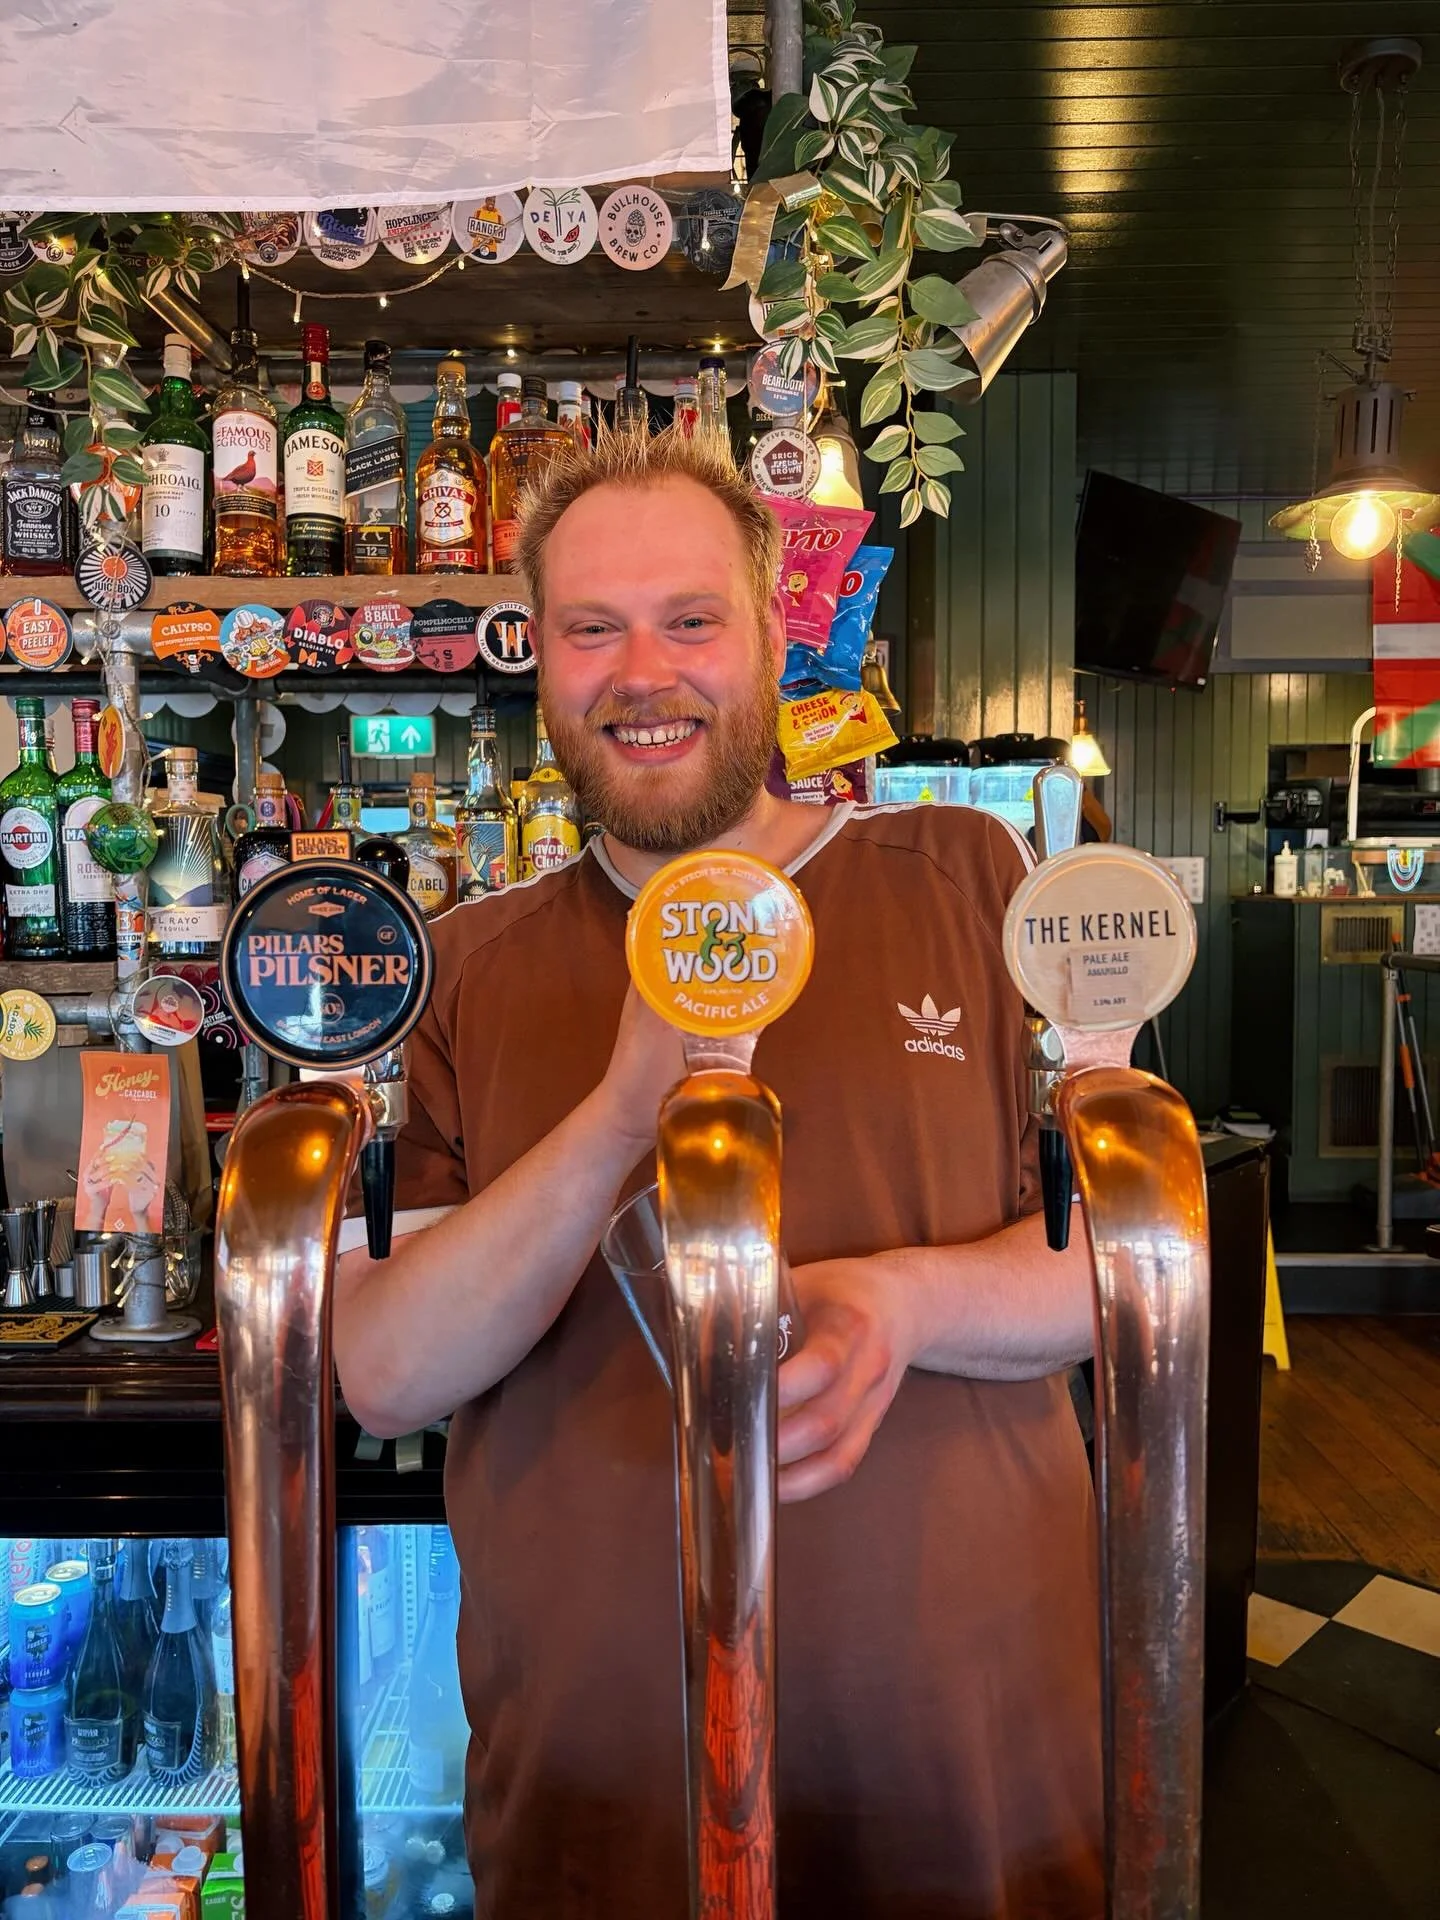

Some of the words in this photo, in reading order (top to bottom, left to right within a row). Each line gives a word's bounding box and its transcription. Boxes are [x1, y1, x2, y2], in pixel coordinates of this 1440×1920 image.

[607, 194, 666, 228] BULLHOUSE
[609, 238, 639, 262] BREW
[643, 244, 658, 259] CO
[762, 374, 805, 392] BEARTOOTH
[221, 426, 271, 443] FAMOUS
[221, 436, 271, 453] GROUSE
[286, 435, 345, 461] JAMESON
[754, 444, 765, 460] THE
[345, 461, 373, 475] BLACK
[374, 452, 401, 466] LABEL
[772, 451, 799, 460] BRICK
[6, 487, 28, 504] JACK
[28, 485, 63, 506] DANIEL'S
[421, 486, 467, 501] CHIVAS
[155, 503, 171, 518] 10
[14, 531, 56, 540] WHISKEY
[365, 546, 378, 556] 12
[454, 551, 467, 563] 12
[365, 611, 373, 623] 8
[374, 609, 401, 622] BALL
[483, 609, 496, 621] THE
[498, 603, 523, 611] WHITE
[23, 620, 52, 634] EASY
[161, 622, 212, 636] CALYPSO
[414, 616, 475, 627] POMPELMOCELLO
[22, 635, 54, 649] PEELER
[293, 627, 345, 650] DIABLO
[790, 697, 830, 716] CHEESE
[790, 776, 824, 790] SAUCE
[2, 832, 47, 843] MARTINI
[528, 842, 573, 855] Havana
[316, 886, 331, 895] OF
[332, 887, 368, 905] LAGER
[169, 916, 199, 925] RAYO
[660, 900, 778, 940] STONE
[1025, 916, 1070, 944] THE
[1081, 909, 1177, 942] KERNEL
[248, 935, 345, 955] PILLARS
[662, 948, 778, 984] WOOD
[1083, 953, 1109, 964] PALE
[1111, 951, 1130, 963] ALE
[248, 955, 409, 986] PILSNER
[673, 991, 738, 1019] PACIFIC
[742, 991, 770, 1016] ALE
[904, 1036, 965, 1061] adidas
[95, 1068, 159, 1097] Honey
[124, 1089, 157, 1099] CAZCABEL
